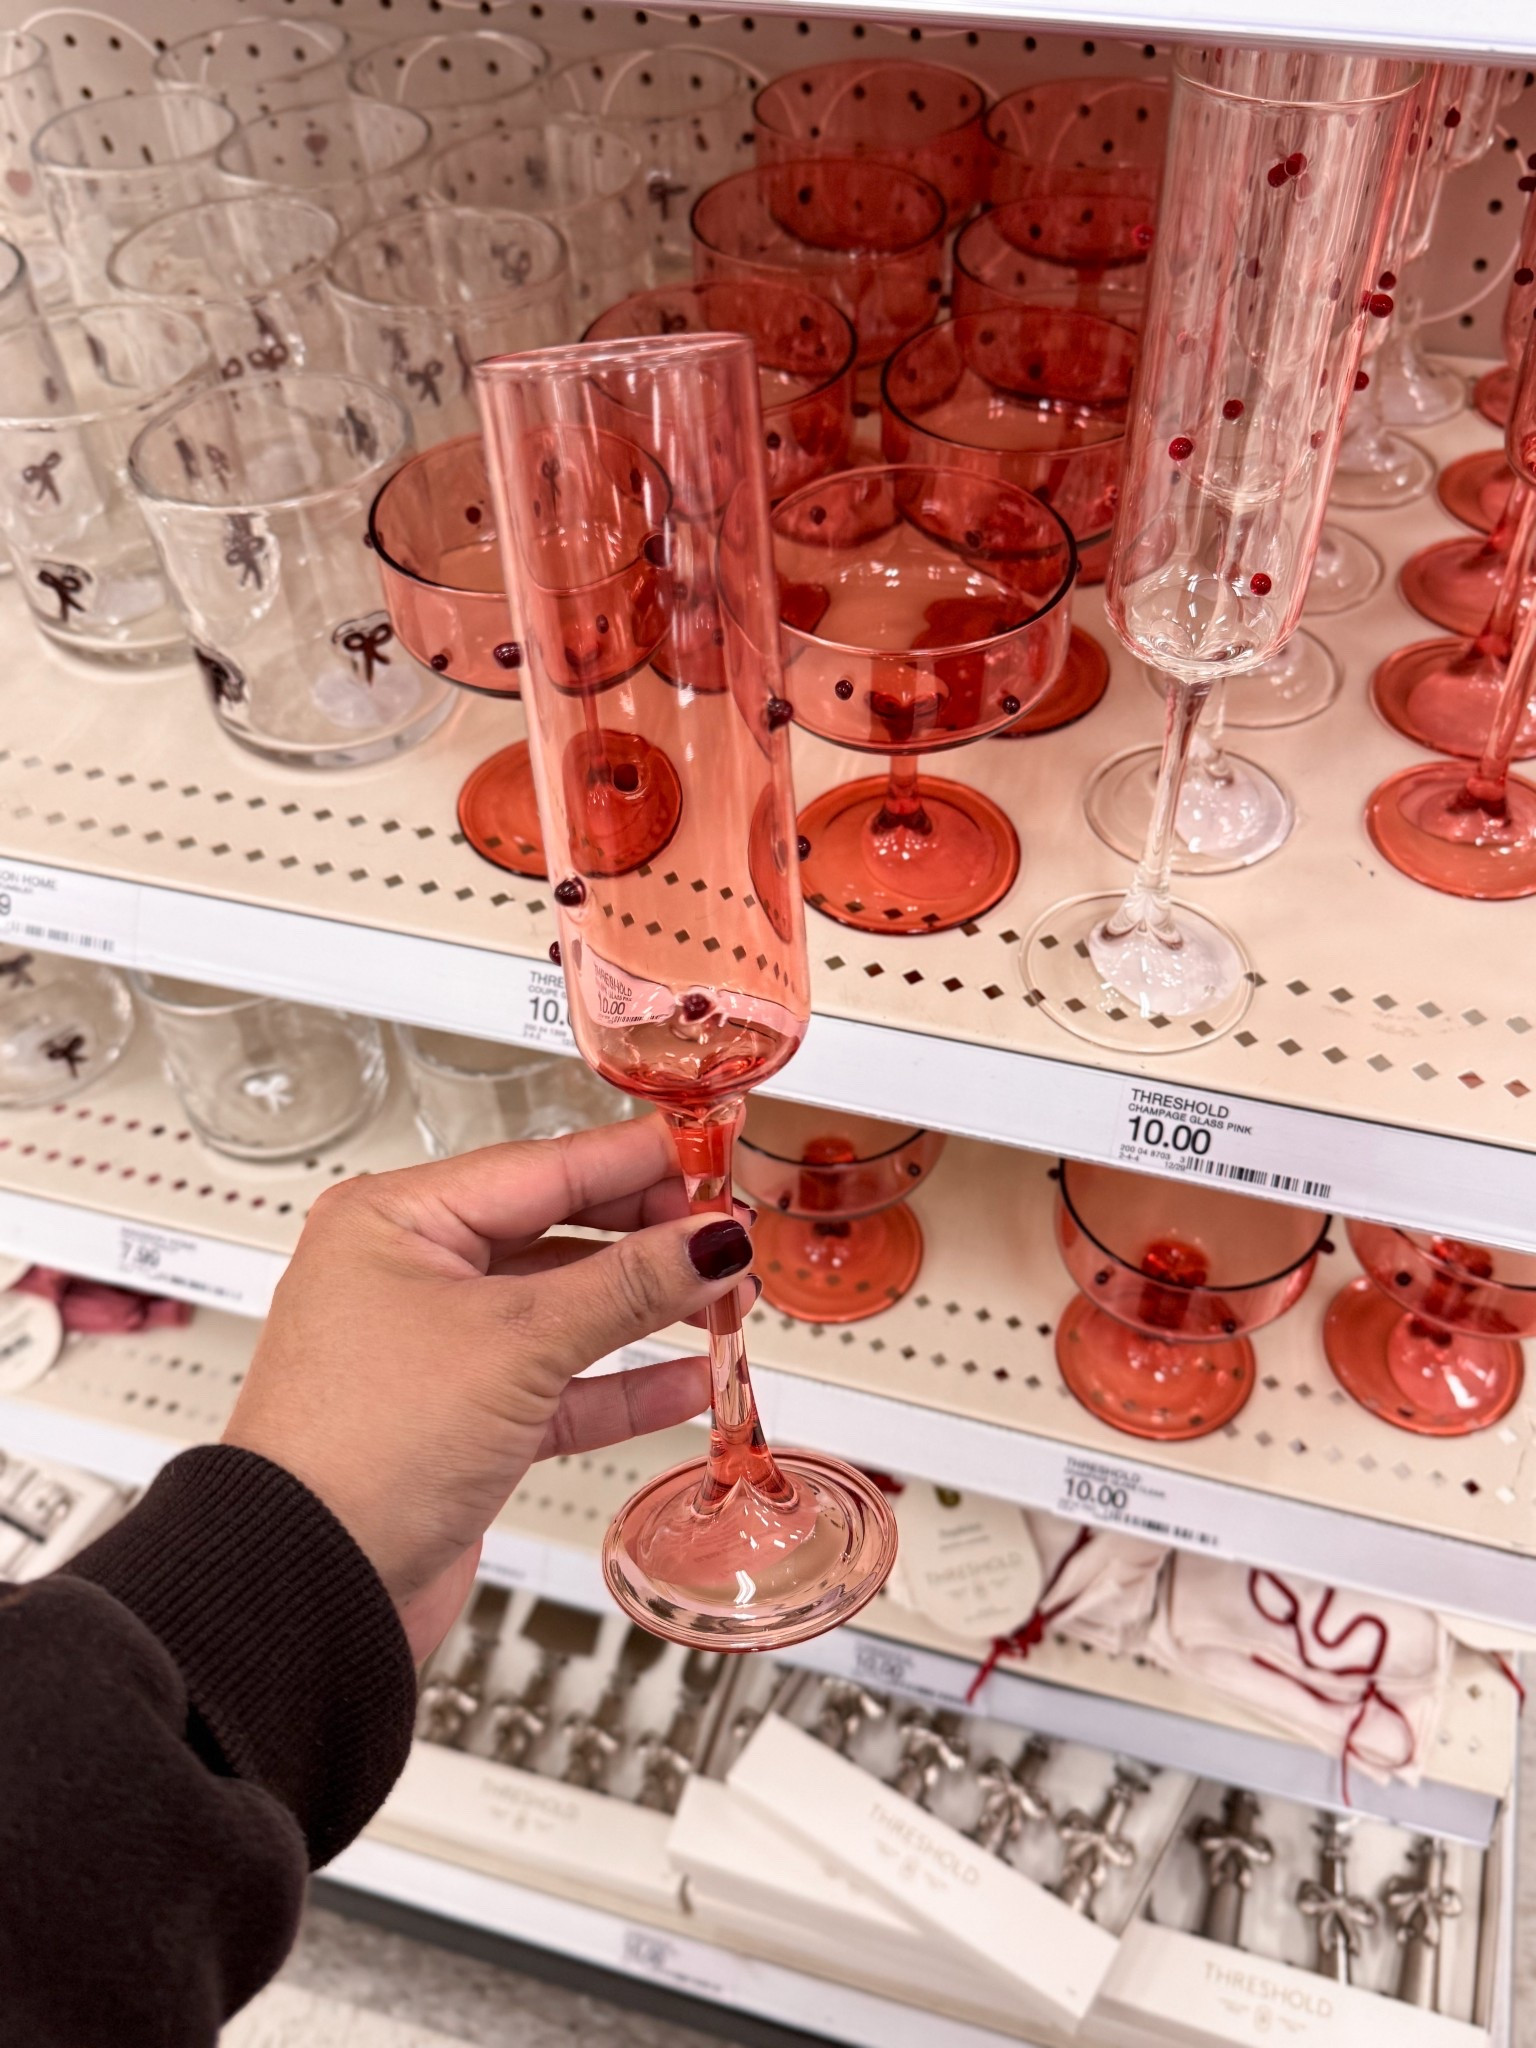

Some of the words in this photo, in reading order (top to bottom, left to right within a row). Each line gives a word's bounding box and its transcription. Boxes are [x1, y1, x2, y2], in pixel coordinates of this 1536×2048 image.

[22, 874, 57, 890] HOME
[528, 985, 558, 997] COUPE
[530, 996, 570, 1025] 10.
[1128, 1103, 1187, 1122] CHAMPAGE
[1189, 1115, 1224, 1129] GLASS
[1226, 1122, 1253, 1135] PINK
[1131, 1088, 1229, 1119] THRESHOLD
[1128, 1115, 1211, 1155] 10.00
[1065, 1477, 1127, 1509] 10.00
[1205, 1960, 1334, 2019] THRESHOLD
